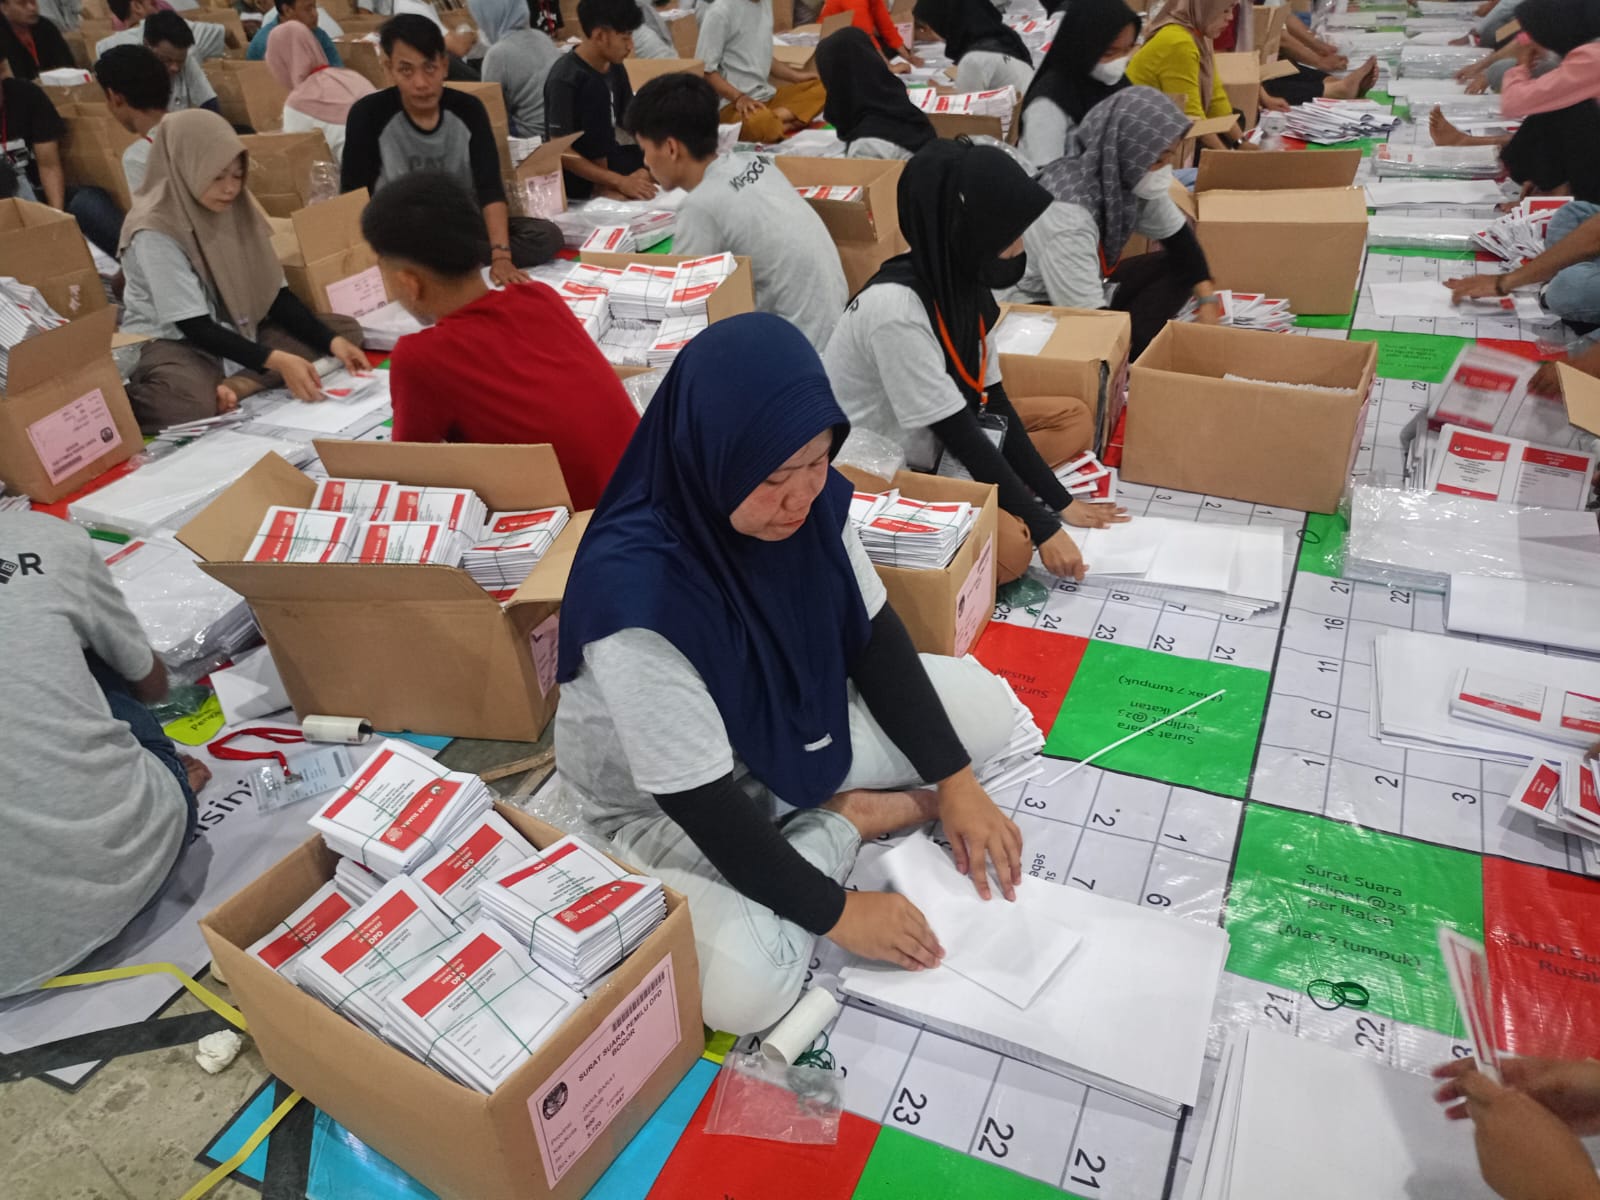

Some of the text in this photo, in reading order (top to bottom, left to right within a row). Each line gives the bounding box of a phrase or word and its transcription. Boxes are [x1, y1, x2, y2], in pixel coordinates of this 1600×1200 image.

[1330, 580, 1350, 595] 21
[1390, 589, 1411, 605] 22
[1043, 614, 1062, 630] 24
[1325, 615, 1345, 631] 16
[1096, 624, 1117, 641] 23
[1154, 634, 1175, 652] 22
[1214, 645, 1236, 662] 21
[1317, 659, 1339, 673] 11
[1118, 675, 1174, 693] tumpuk)
[1311, 707, 1332, 720] 6
[1158, 731, 1195, 745] Surat
[1302, 756, 1326, 769] 1
[1375, 774, 1399, 788] 2
[1024, 796, 1047, 811] 3
[1452, 790, 1476, 804] 3
[1092, 812, 1117, 828] 2
[1164, 832, 1188, 846] 1
[1072, 875, 1096, 892] 7
[1305, 864, 1402, 897] Surat Suara
[1147, 893, 1171, 908] 6
[1307, 898, 1337, 912] per
[303, 930, 318, 943] DPD
[368, 930, 384, 945] DPD
[1508, 932, 1566, 957] Surat
[1342, 938, 1421, 969] tumpuk)
[451, 971, 466, 986] DPD
[1264, 991, 1294, 1024] 21
[578, 987, 662, 1083] SURAT SUARA PEMILU DPD
[611, 1026, 635, 1057] BOGOR
[893, 1088, 927, 1126] 23
[977, 1117, 1013, 1159] 22
[1070, 1148, 1105, 1189] 21
